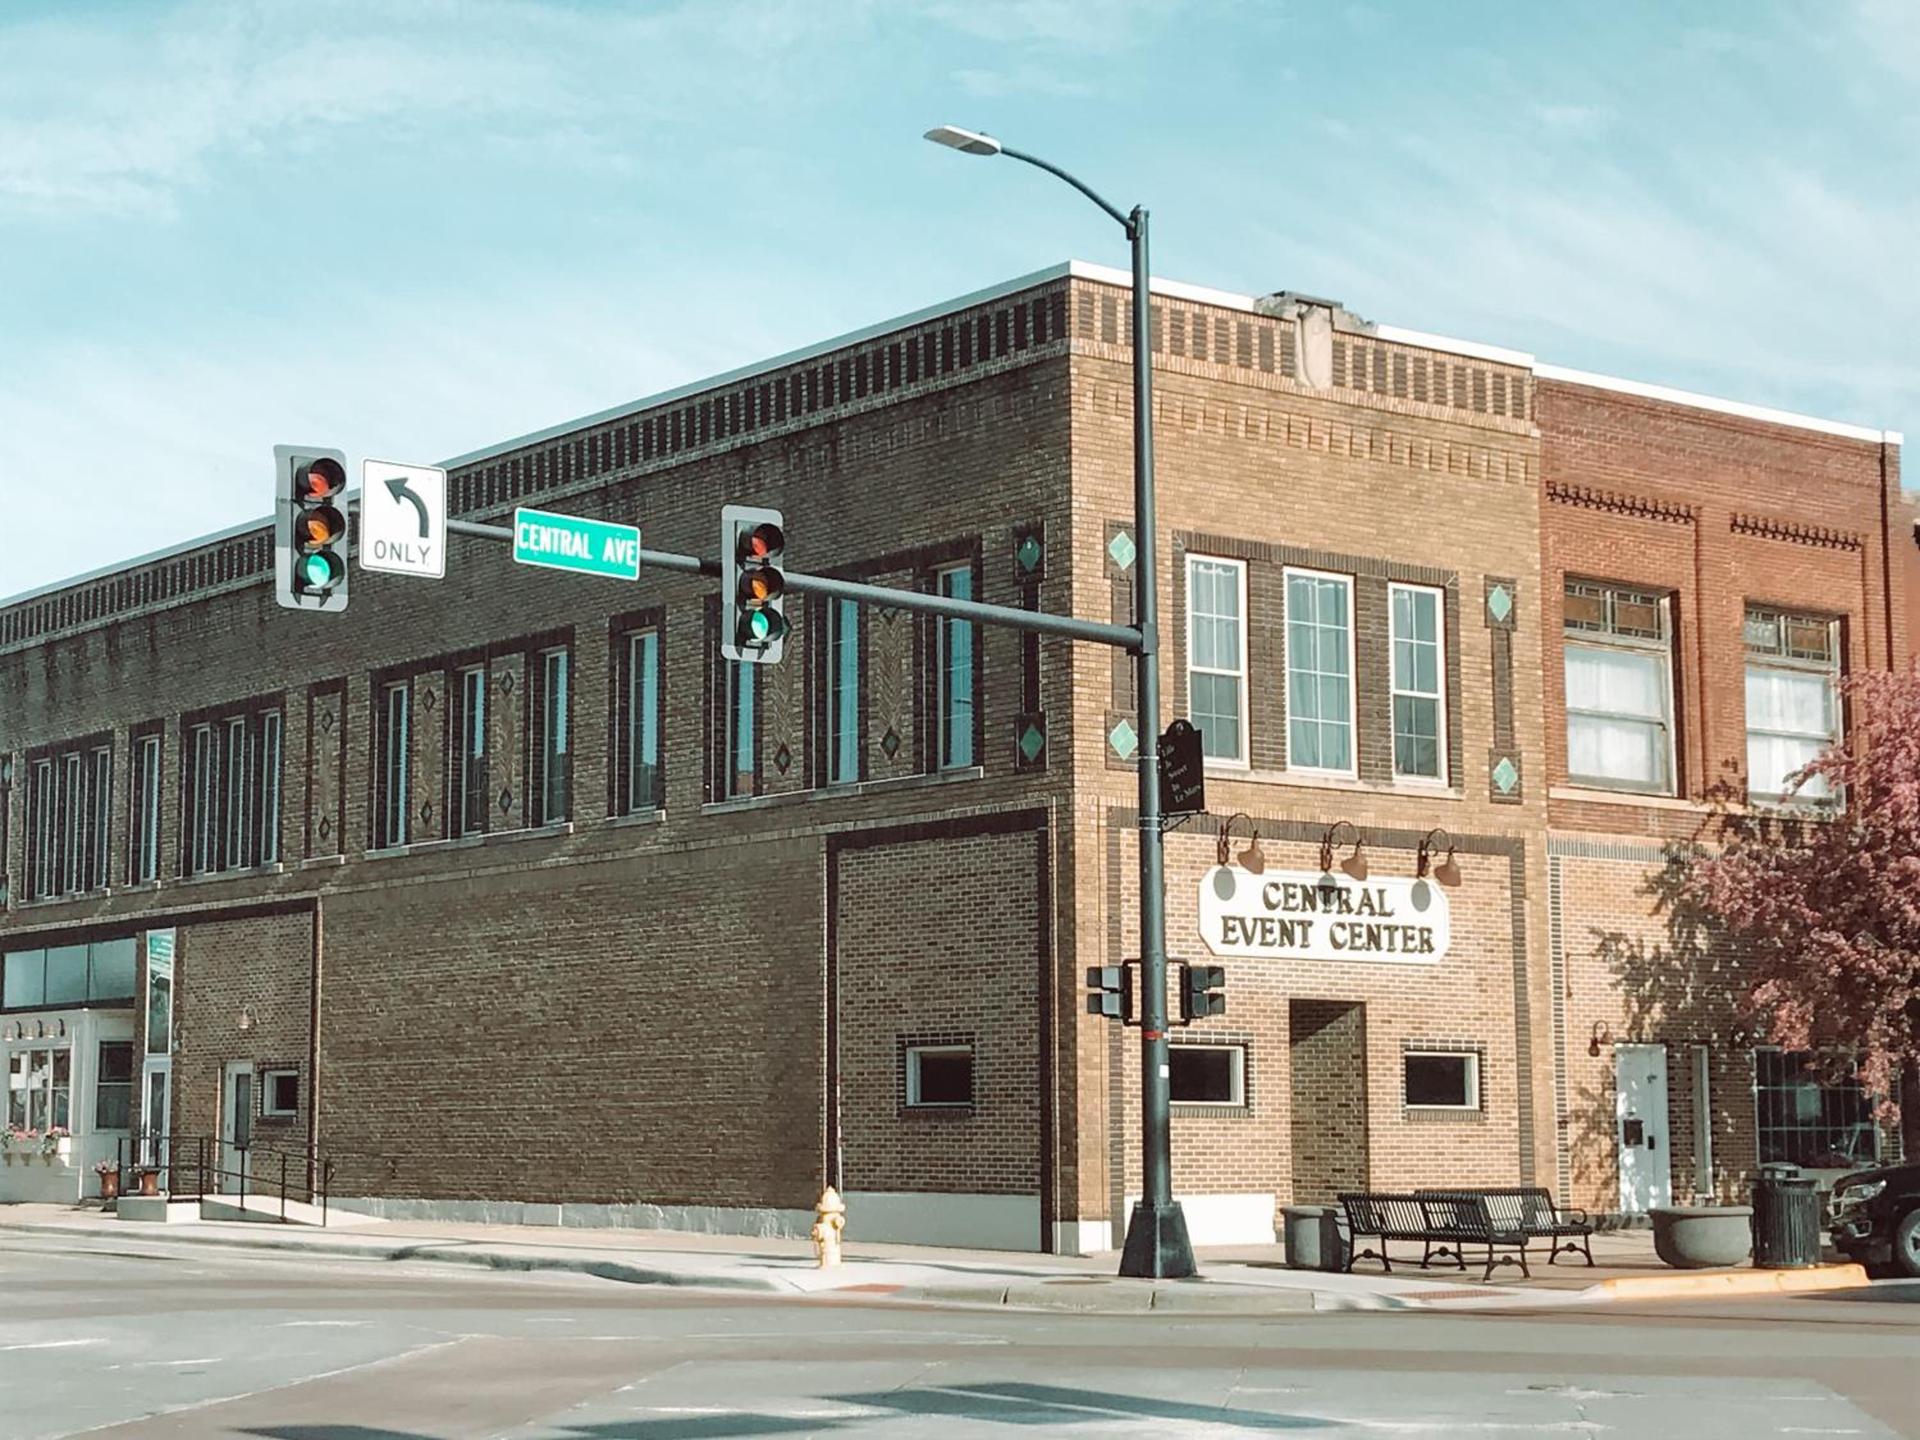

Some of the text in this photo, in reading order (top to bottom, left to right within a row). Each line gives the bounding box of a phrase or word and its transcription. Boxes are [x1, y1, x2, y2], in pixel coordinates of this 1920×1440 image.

[374, 539, 431, 565] ONLY
[518, 522, 637, 567] CENTRAL AVE
[1262, 882, 1395, 917] CENTRAL
[1220, 915, 1436, 954] EVENT CENTER
